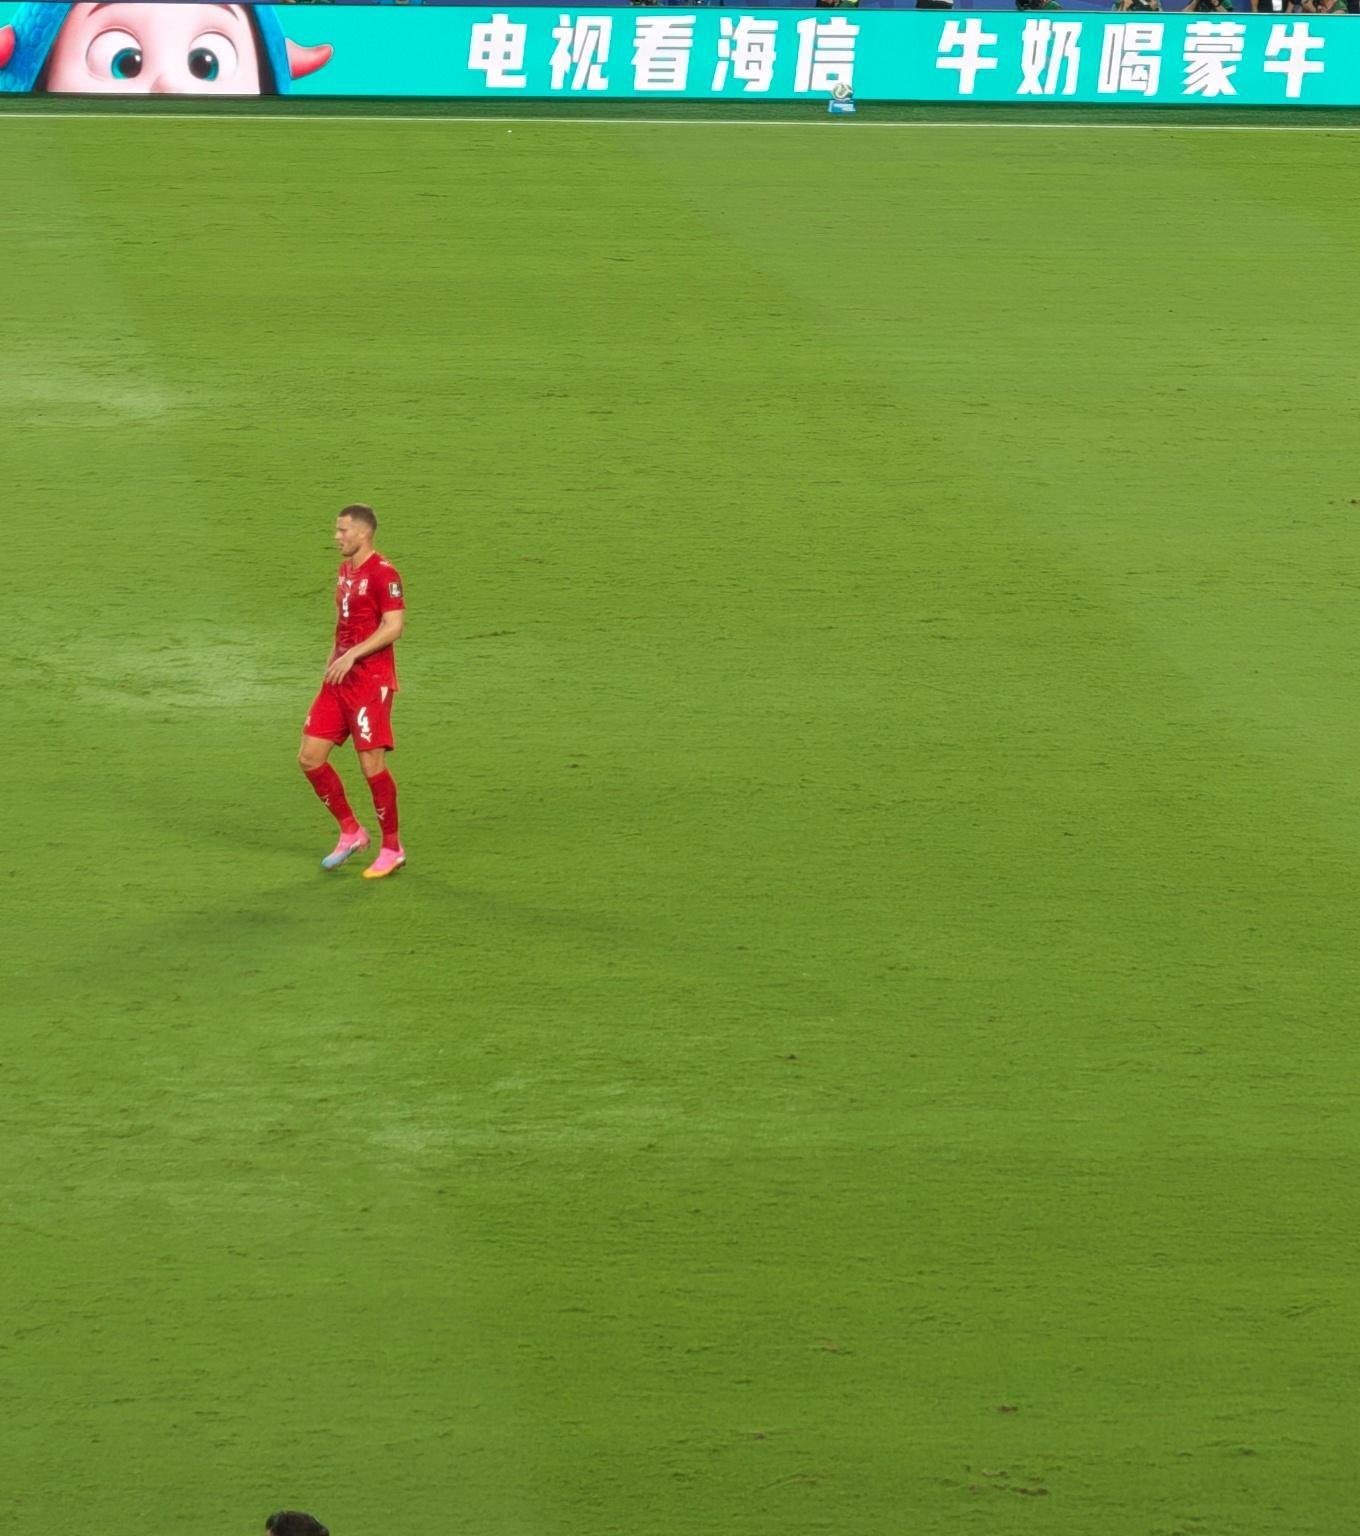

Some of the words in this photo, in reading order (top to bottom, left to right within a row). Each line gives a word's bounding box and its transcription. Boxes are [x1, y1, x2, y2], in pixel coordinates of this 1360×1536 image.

[469, 14, 858, 92] 电视看海信
[937, 19, 1323, 97] 牛奶喝蒙牛
[357, 706, 370, 733] 4
